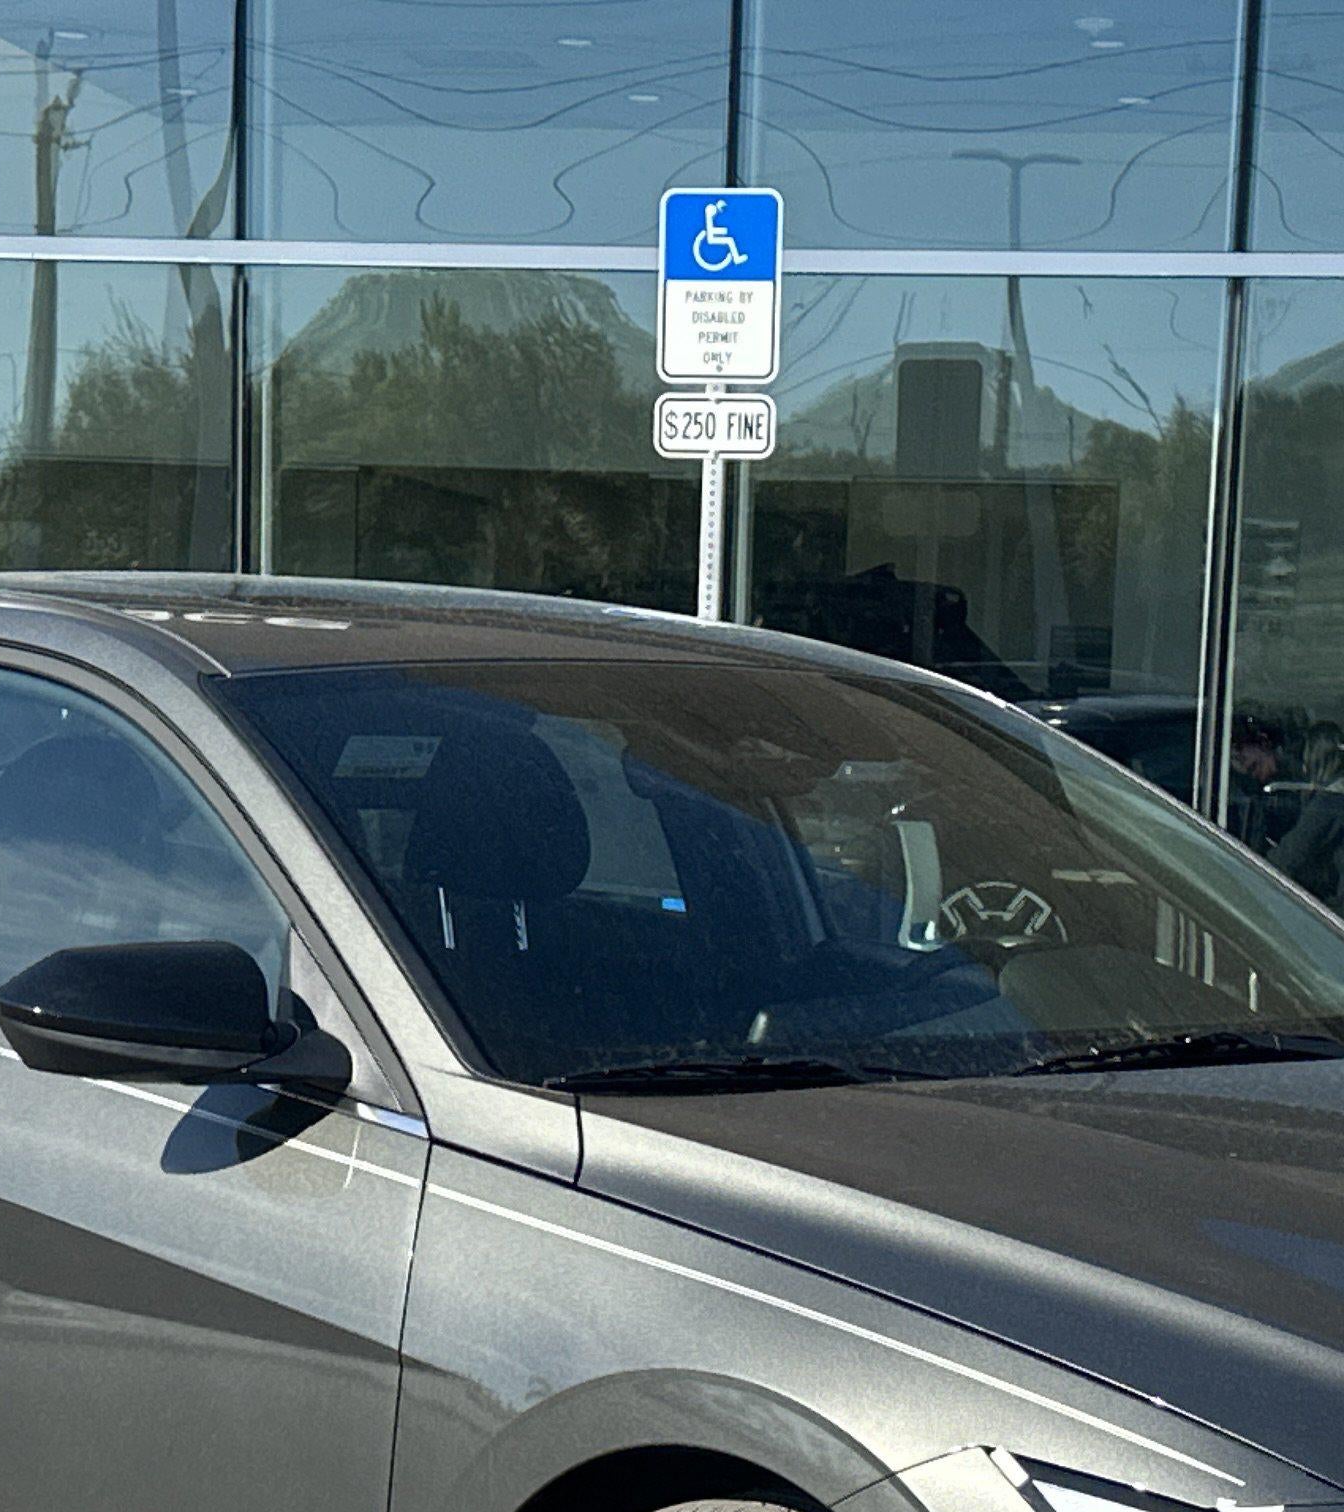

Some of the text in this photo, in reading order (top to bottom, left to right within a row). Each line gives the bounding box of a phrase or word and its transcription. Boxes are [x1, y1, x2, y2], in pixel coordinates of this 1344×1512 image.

[684, 290, 755, 305] PARKING BY
[691, 310, 746, 325] DISABLED
[697, 331, 738, 345] PERMIT
[702, 351, 734, 365] ONLY
[664, 410, 765, 440] $250 FINE
